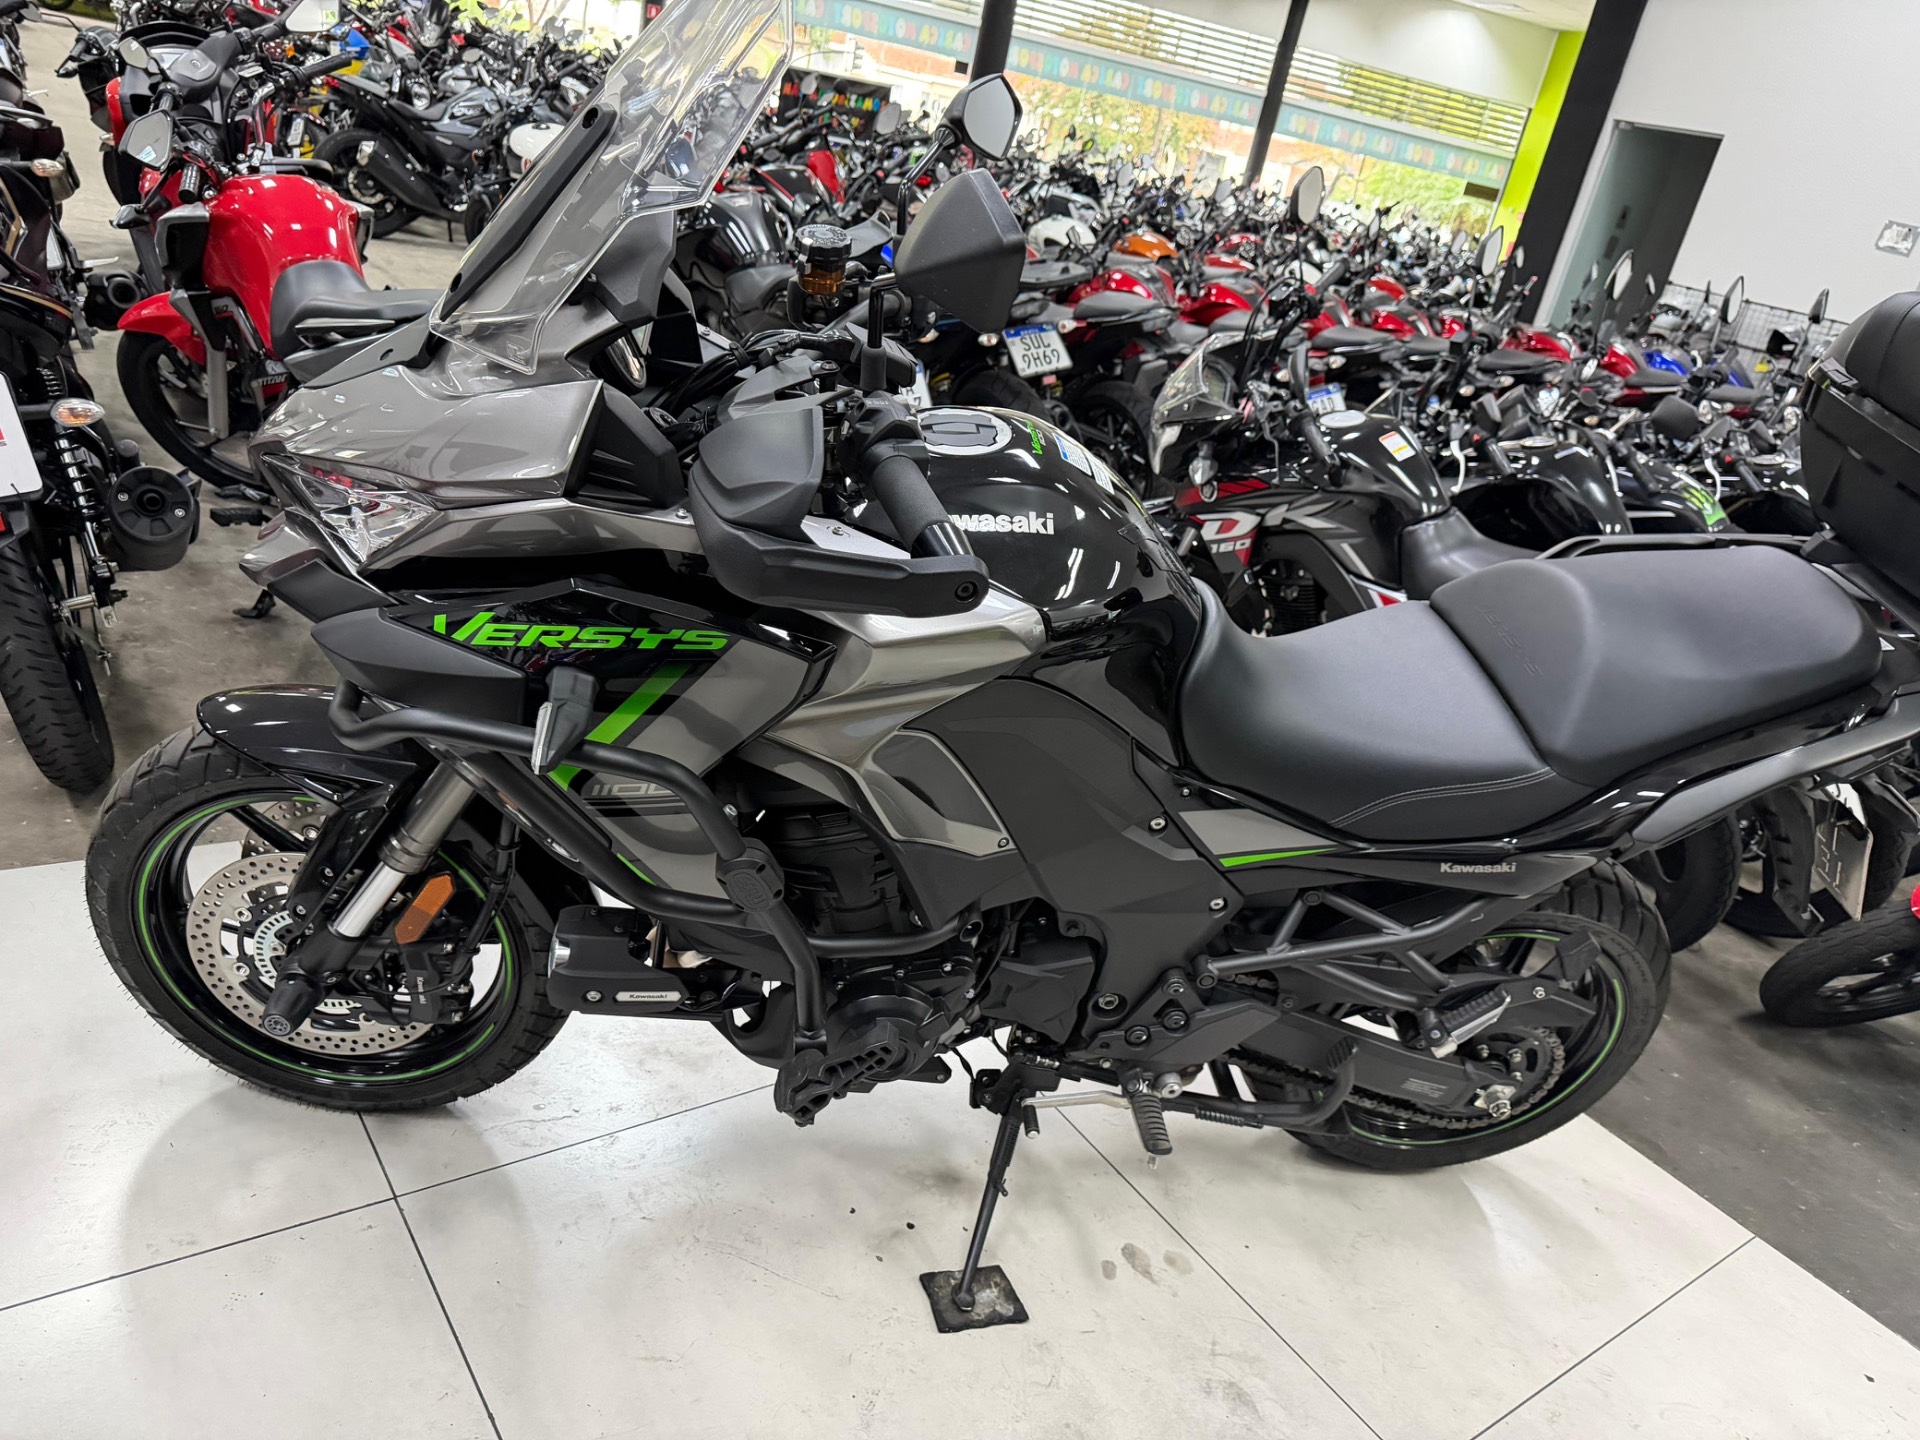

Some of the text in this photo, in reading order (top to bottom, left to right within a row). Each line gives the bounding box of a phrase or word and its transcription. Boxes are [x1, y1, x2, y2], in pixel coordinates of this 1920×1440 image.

[1022, 348, 1060, 369] 9H69
[947, 511, 1055, 535] wasaki
[1210, 538, 1253, 554] 160
[433, 611, 731, 650] VERSYS
[1440, 862, 1517, 873] Kawasaki
[416, 976, 428, 1004] Kawaaki
